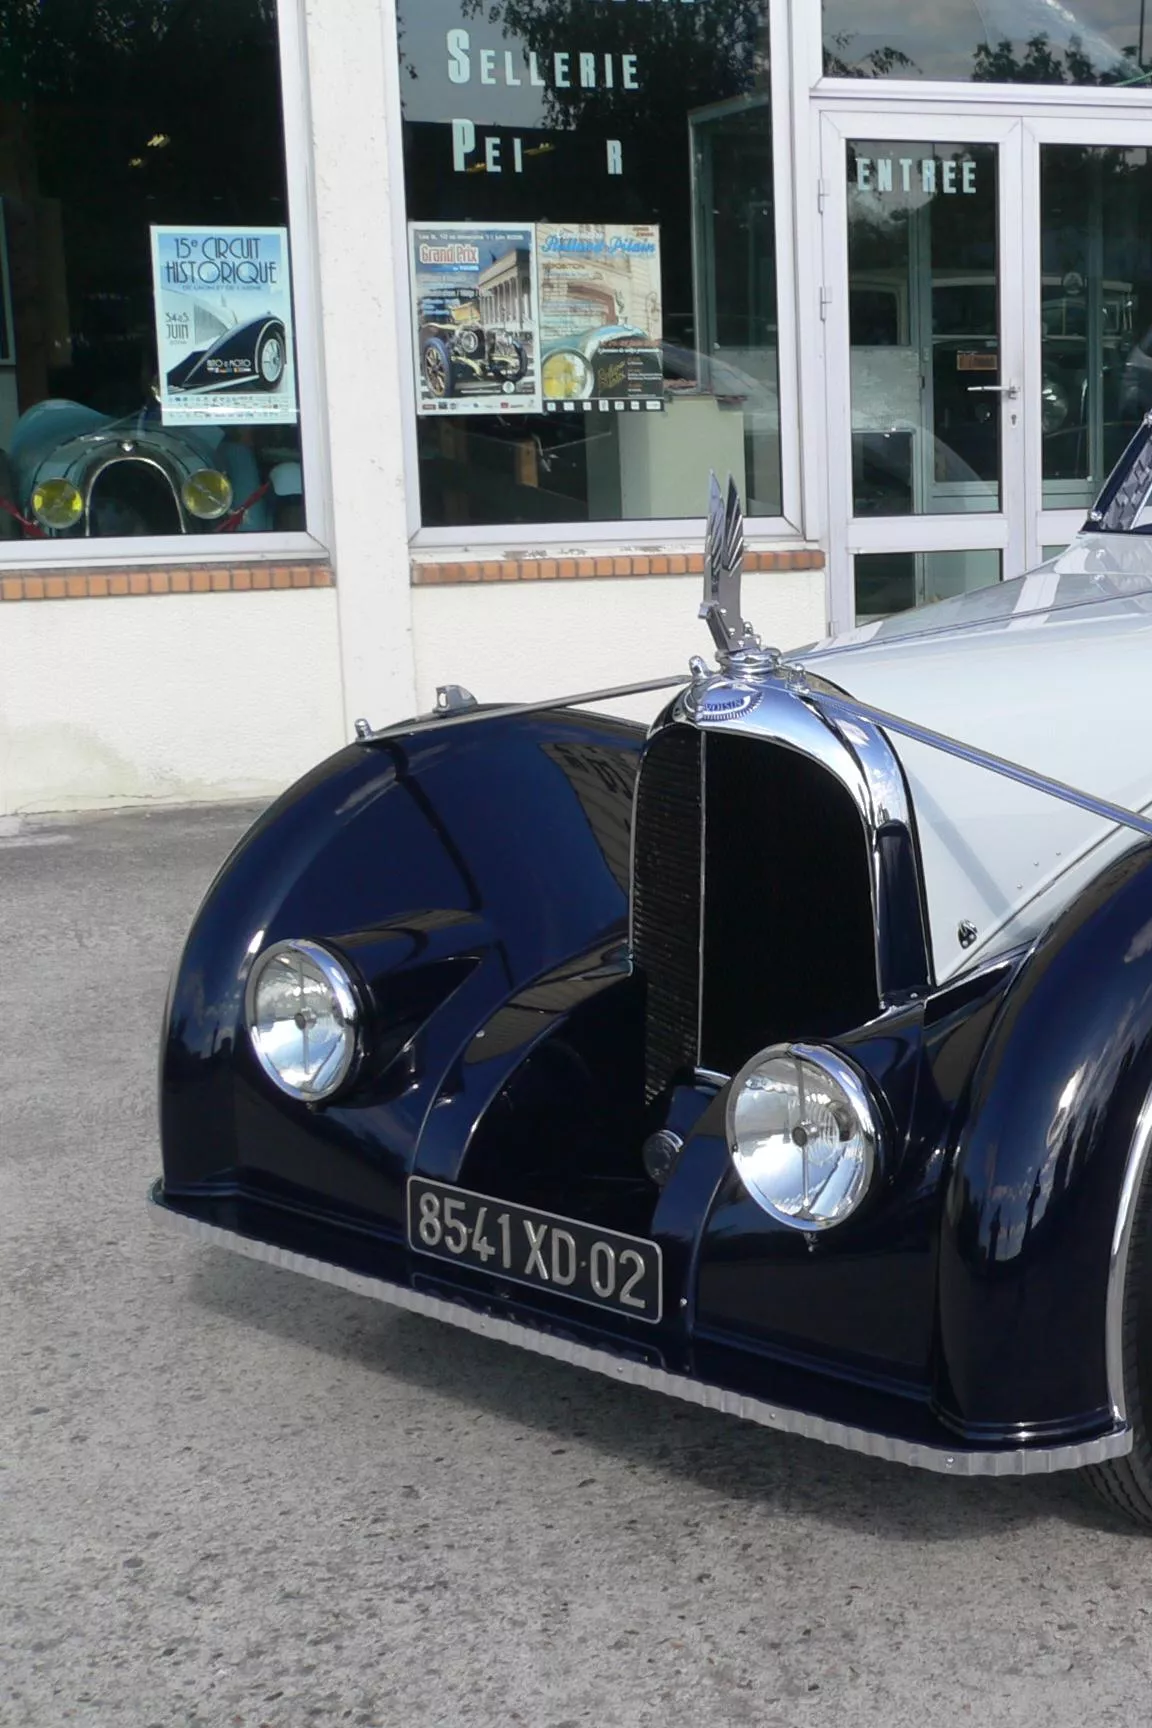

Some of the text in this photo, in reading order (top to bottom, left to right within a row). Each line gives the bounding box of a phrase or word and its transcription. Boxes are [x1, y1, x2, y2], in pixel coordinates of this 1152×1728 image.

[446, 28, 639, 89] SELLERIE
[857, 158, 977, 194] ENTREE
[202, 236, 261, 261] CIRCUIT
[421, 244, 478, 263] Grand Prix
[165, 260, 277, 284] HISTORIQUE
[166, 323, 189, 340] JUIN
[419, 1191, 646, 1309] 8541 XD 02
